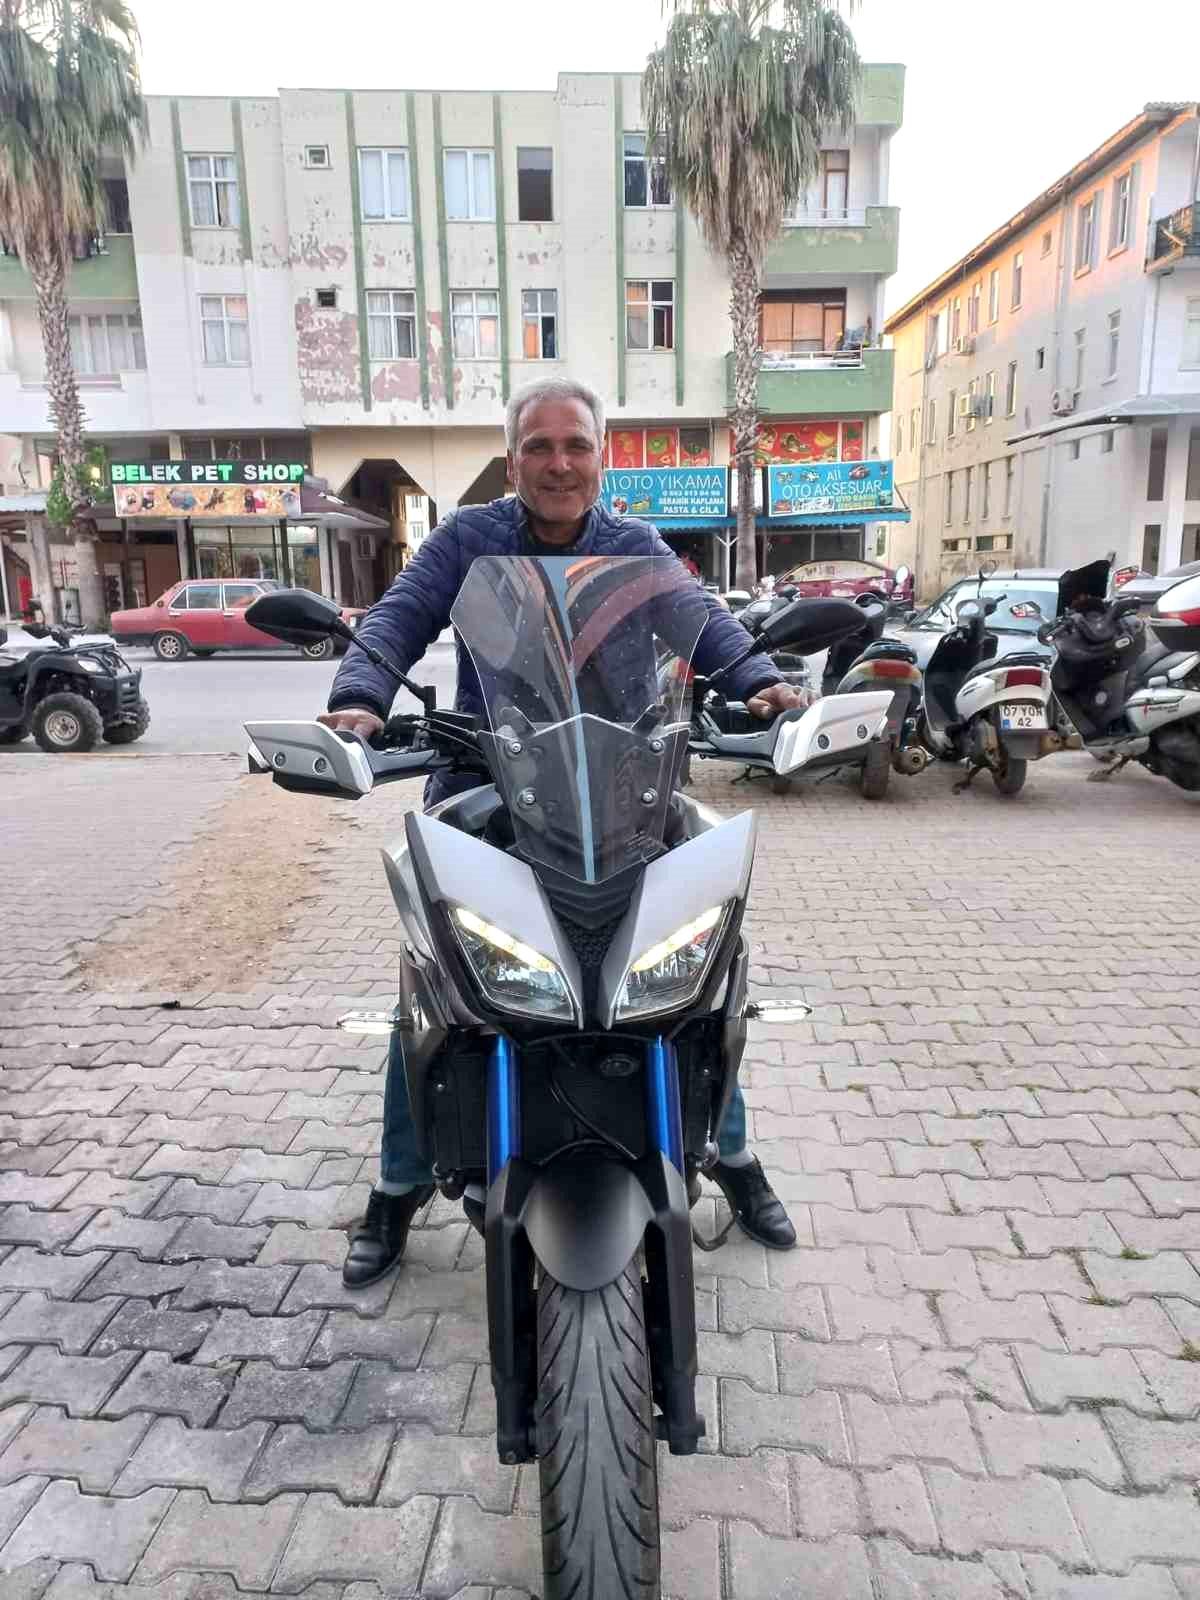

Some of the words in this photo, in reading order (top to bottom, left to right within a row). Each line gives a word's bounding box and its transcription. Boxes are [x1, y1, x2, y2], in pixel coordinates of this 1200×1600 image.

[111, 464, 182, 481] BELEK
[191, 464, 232, 481] PET
[244, 464, 304, 481] SHOP
[619, 475, 653, 490] OTO
[657, 473, 723, 490] YIKAMA
[782, 484, 811, 499] OTO
[814, 479, 882, 497] AKSESUAR
[663, 505, 688, 513] PASTA
[1004, 705, 1017, 717] 07
[1017, 717, 1032, 727] 42
